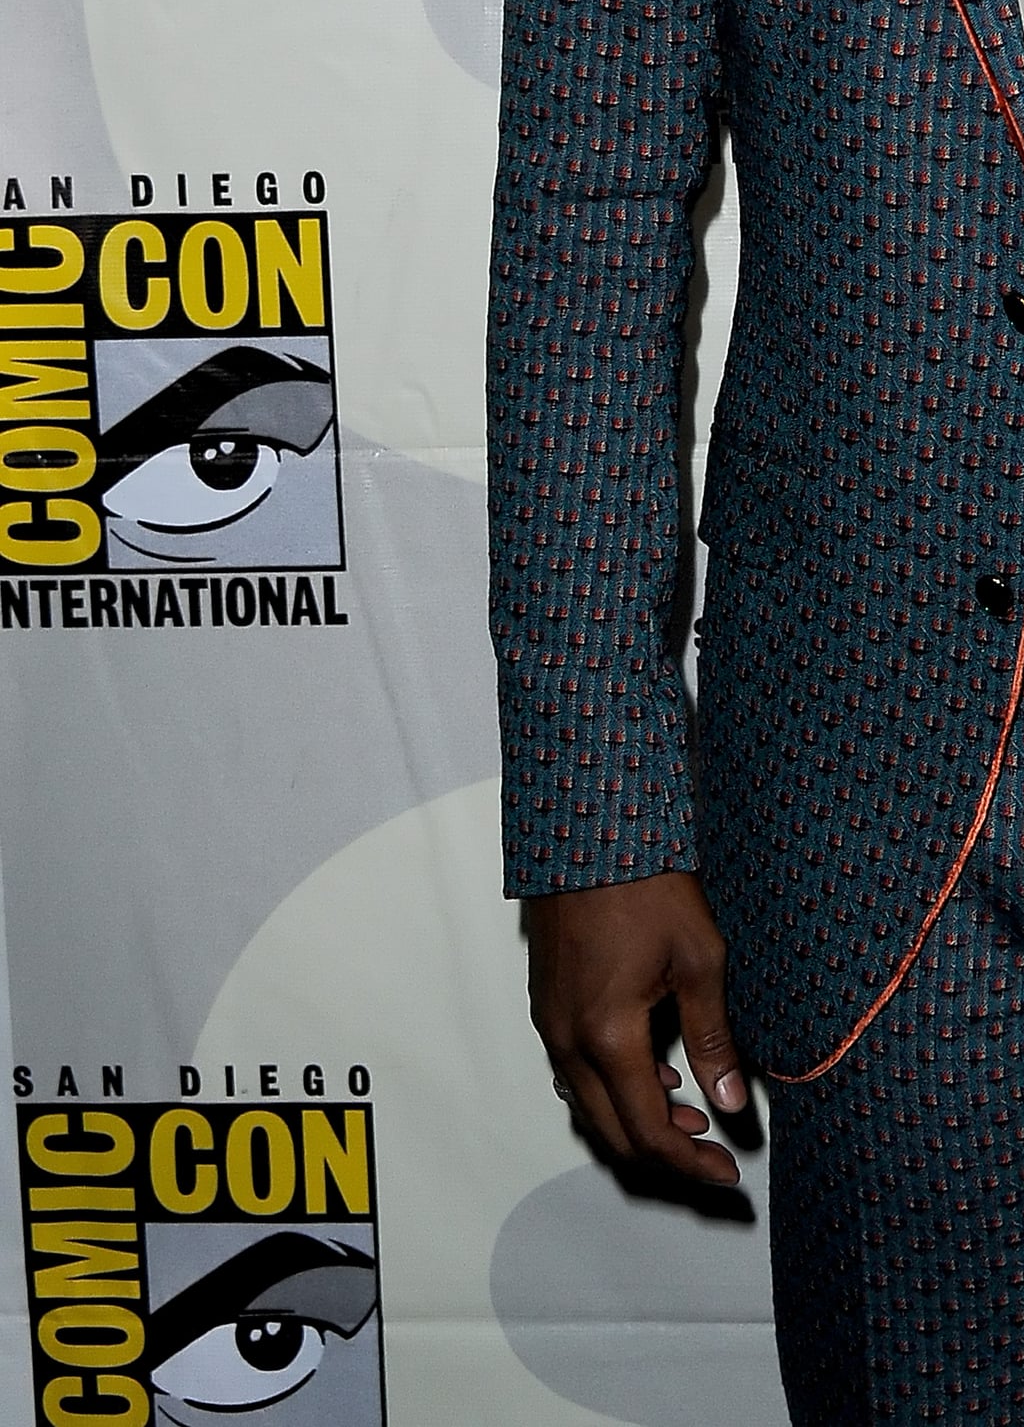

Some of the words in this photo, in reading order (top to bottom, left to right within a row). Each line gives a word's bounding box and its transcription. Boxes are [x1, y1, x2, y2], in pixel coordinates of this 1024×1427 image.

[131, 171, 326, 208] DIEGO
[100, 218, 325, 331] CON
[0, 224, 102, 566] COMIC
[0, 576, 348, 629] NTERNATIONAL
[13, 1066, 124, 1098] SAN
[180, 1064, 371, 1098] DIEGO
[150, 1109, 370, 1215] CON
[26, 1112, 150, 1427] COMIC
